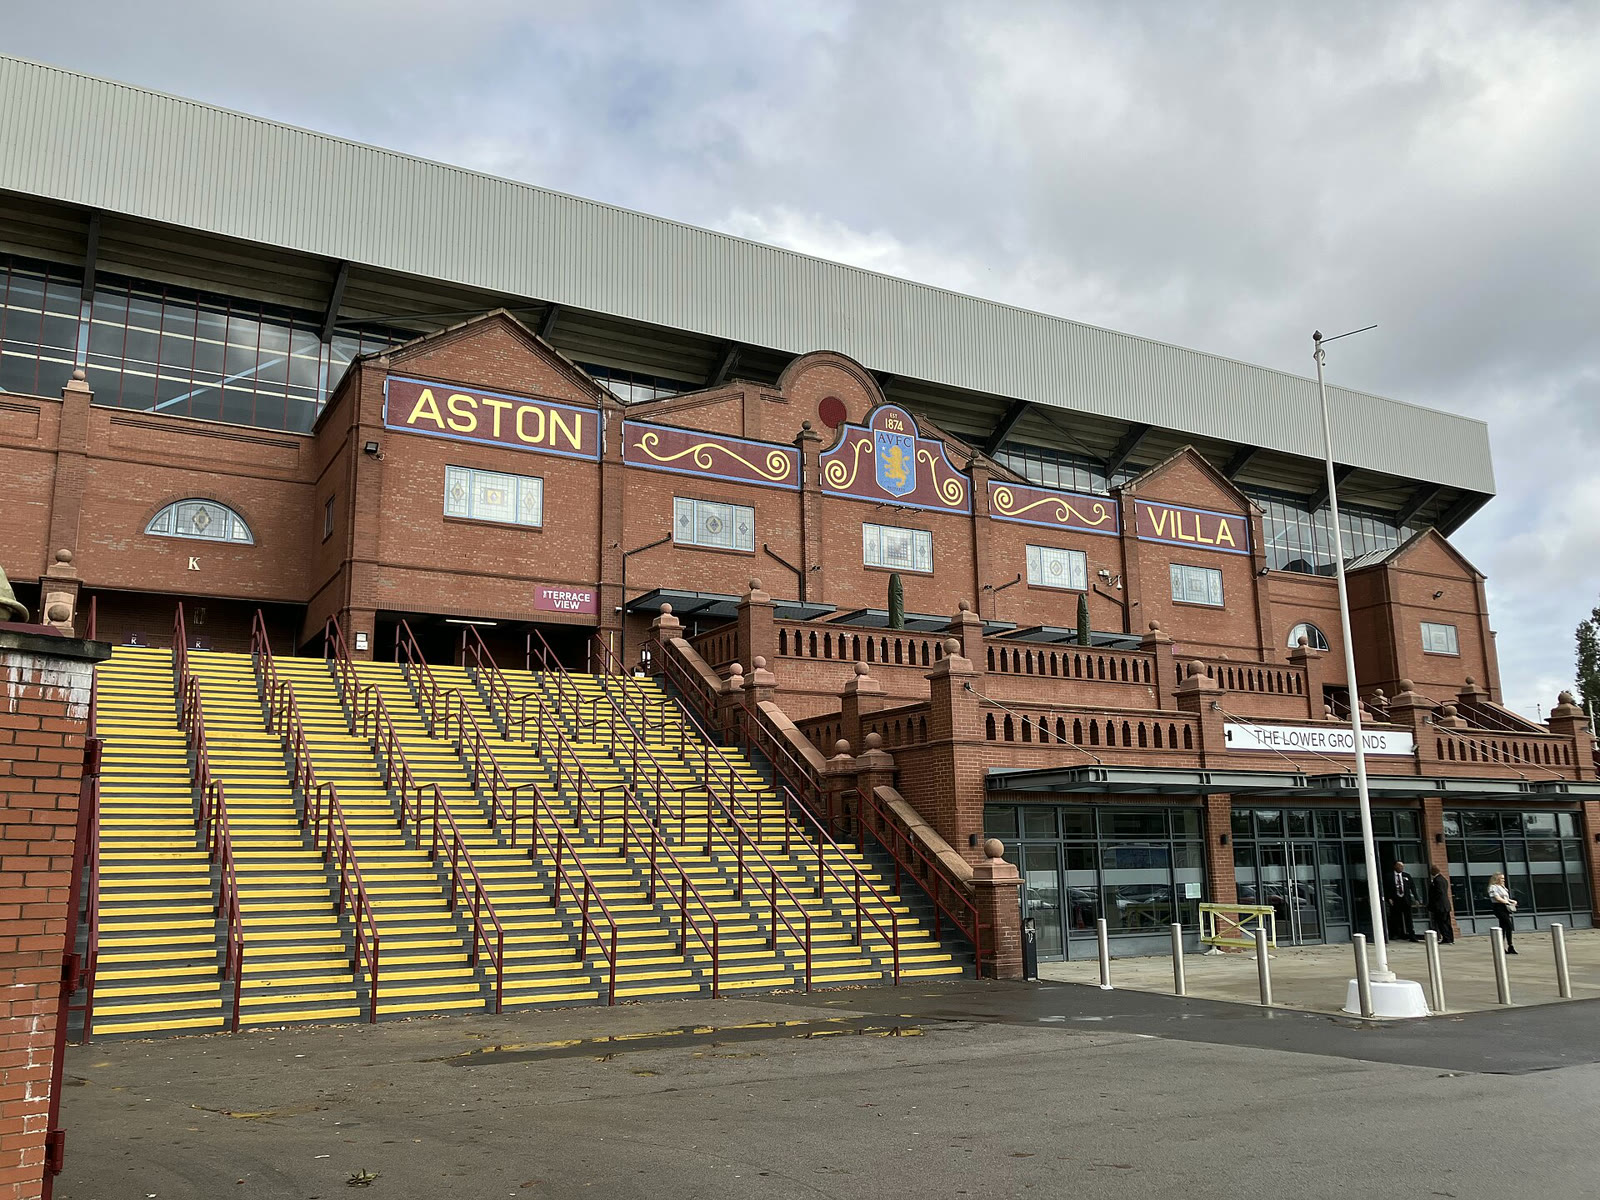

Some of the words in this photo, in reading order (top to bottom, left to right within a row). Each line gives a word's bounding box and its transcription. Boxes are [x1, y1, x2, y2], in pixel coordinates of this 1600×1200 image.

[406, 388, 581, 450] ASTON
[885, 417, 904, 431] 1874
[878, 433, 911, 447] AVFC
[1147, 506, 1236, 548] VILLA
[187, 556, 201, 571] K
[547, 590, 591, 602] TERRACE
[553, 599, 580, 610] VIEW
[1254, 729, 1280, 745] THE
[1282, 731, 1327, 747] LOWER
[1328, 733, 1387, 750] GRONDS
